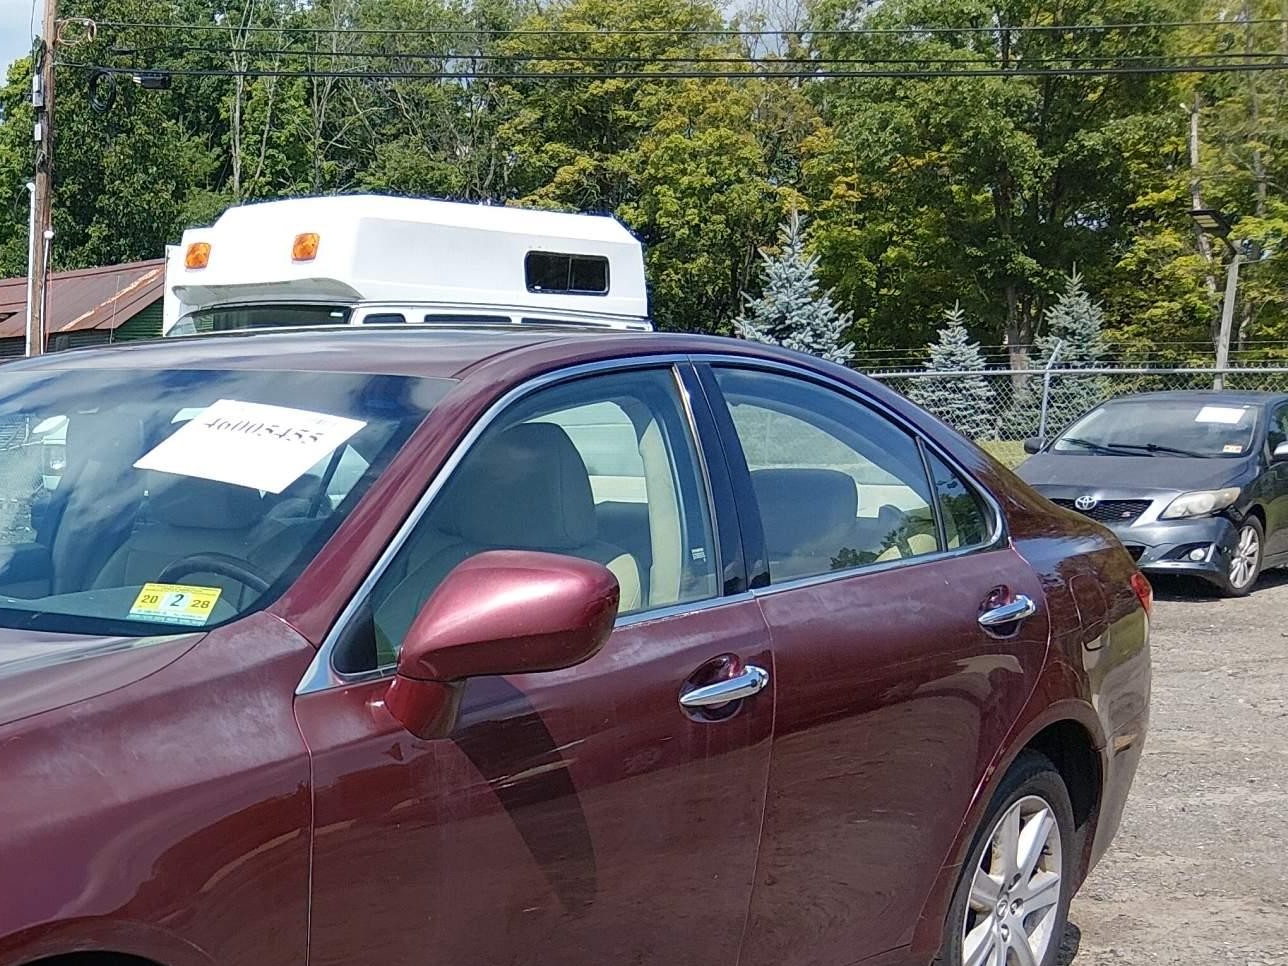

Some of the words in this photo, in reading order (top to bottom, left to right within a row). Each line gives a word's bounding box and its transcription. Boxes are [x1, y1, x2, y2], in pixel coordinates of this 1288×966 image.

[141, 594, 159, 604] 20
[169, 593, 185, 607] 2
[191, 599, 211, 609] 28
